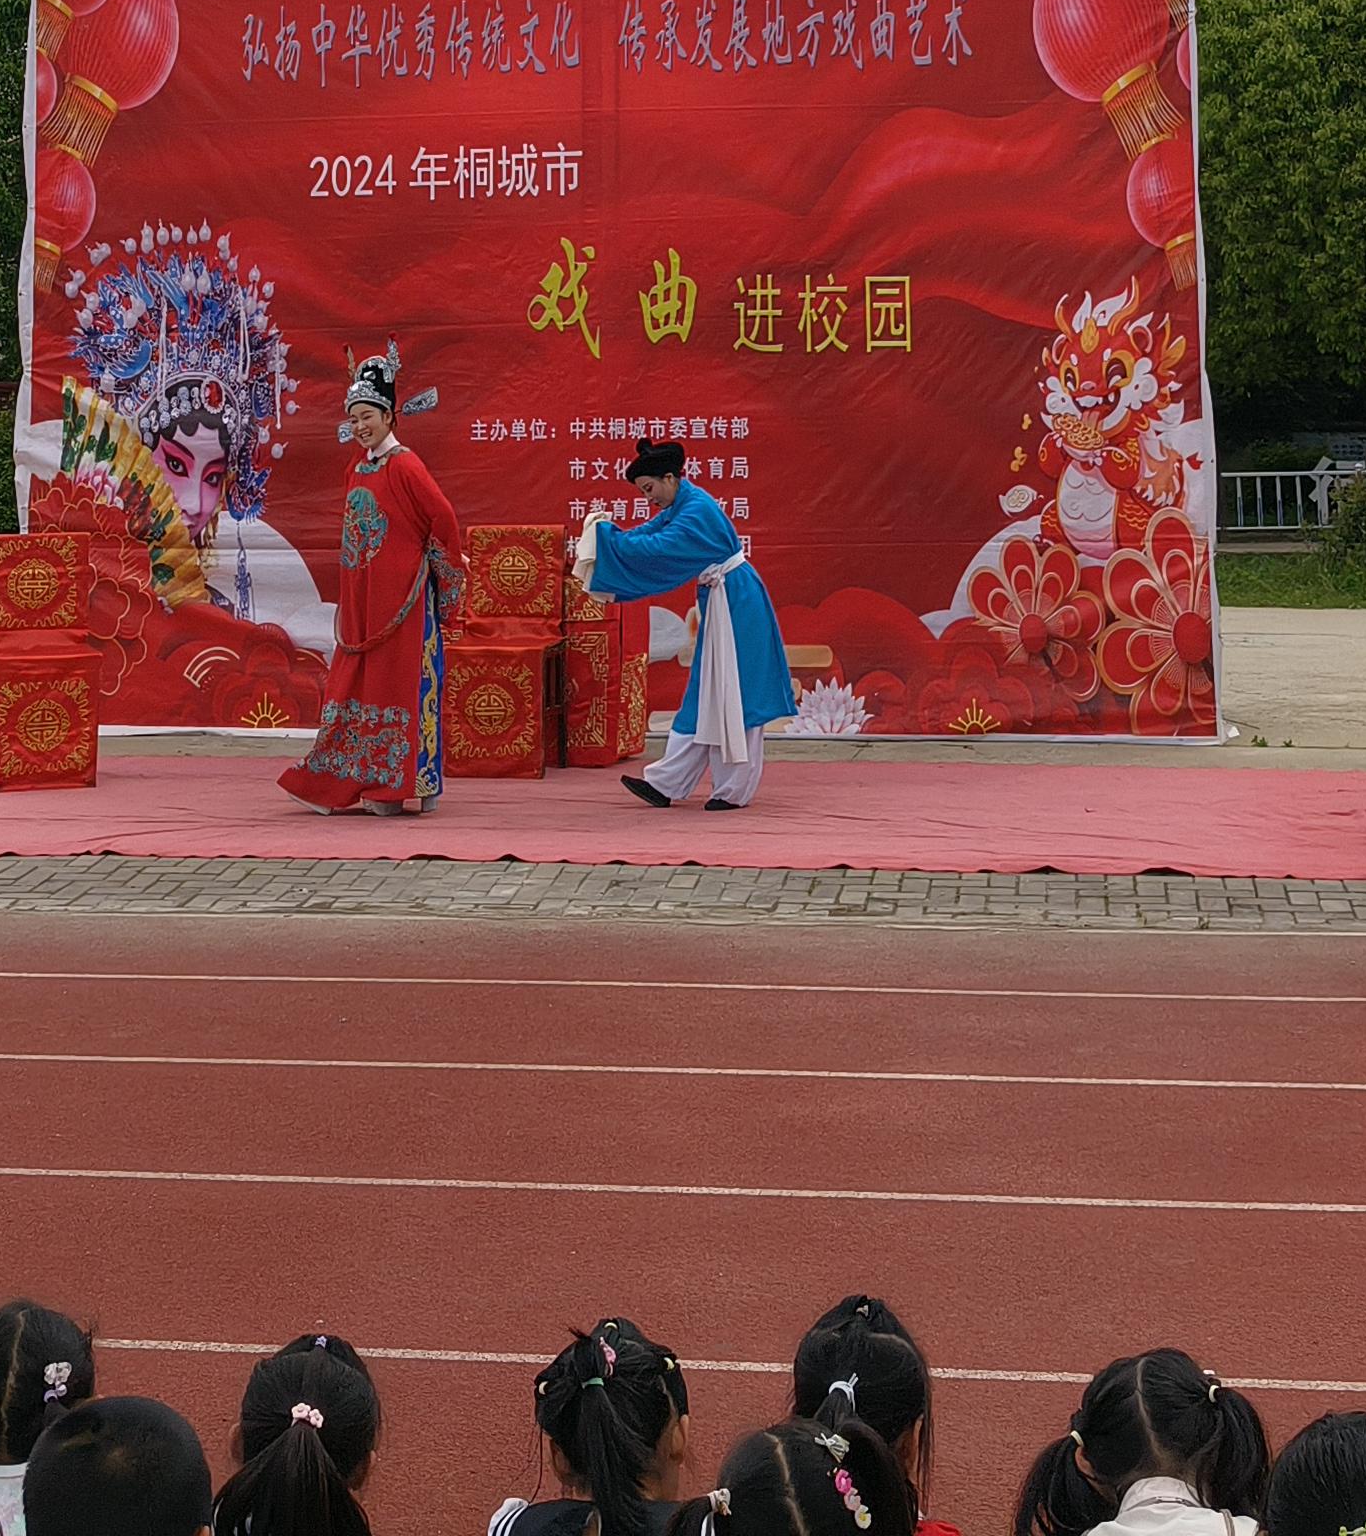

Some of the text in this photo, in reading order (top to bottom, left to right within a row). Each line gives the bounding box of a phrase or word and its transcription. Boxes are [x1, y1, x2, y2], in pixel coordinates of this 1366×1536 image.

[241, 0, 580, 87] 弘扬中华优秀传统文化
[308, 141, 584, 201] 2024 年桐城市
[733, 273, 913, 353] 进校园
[568, 456, 750, 481] 市文化体育局
